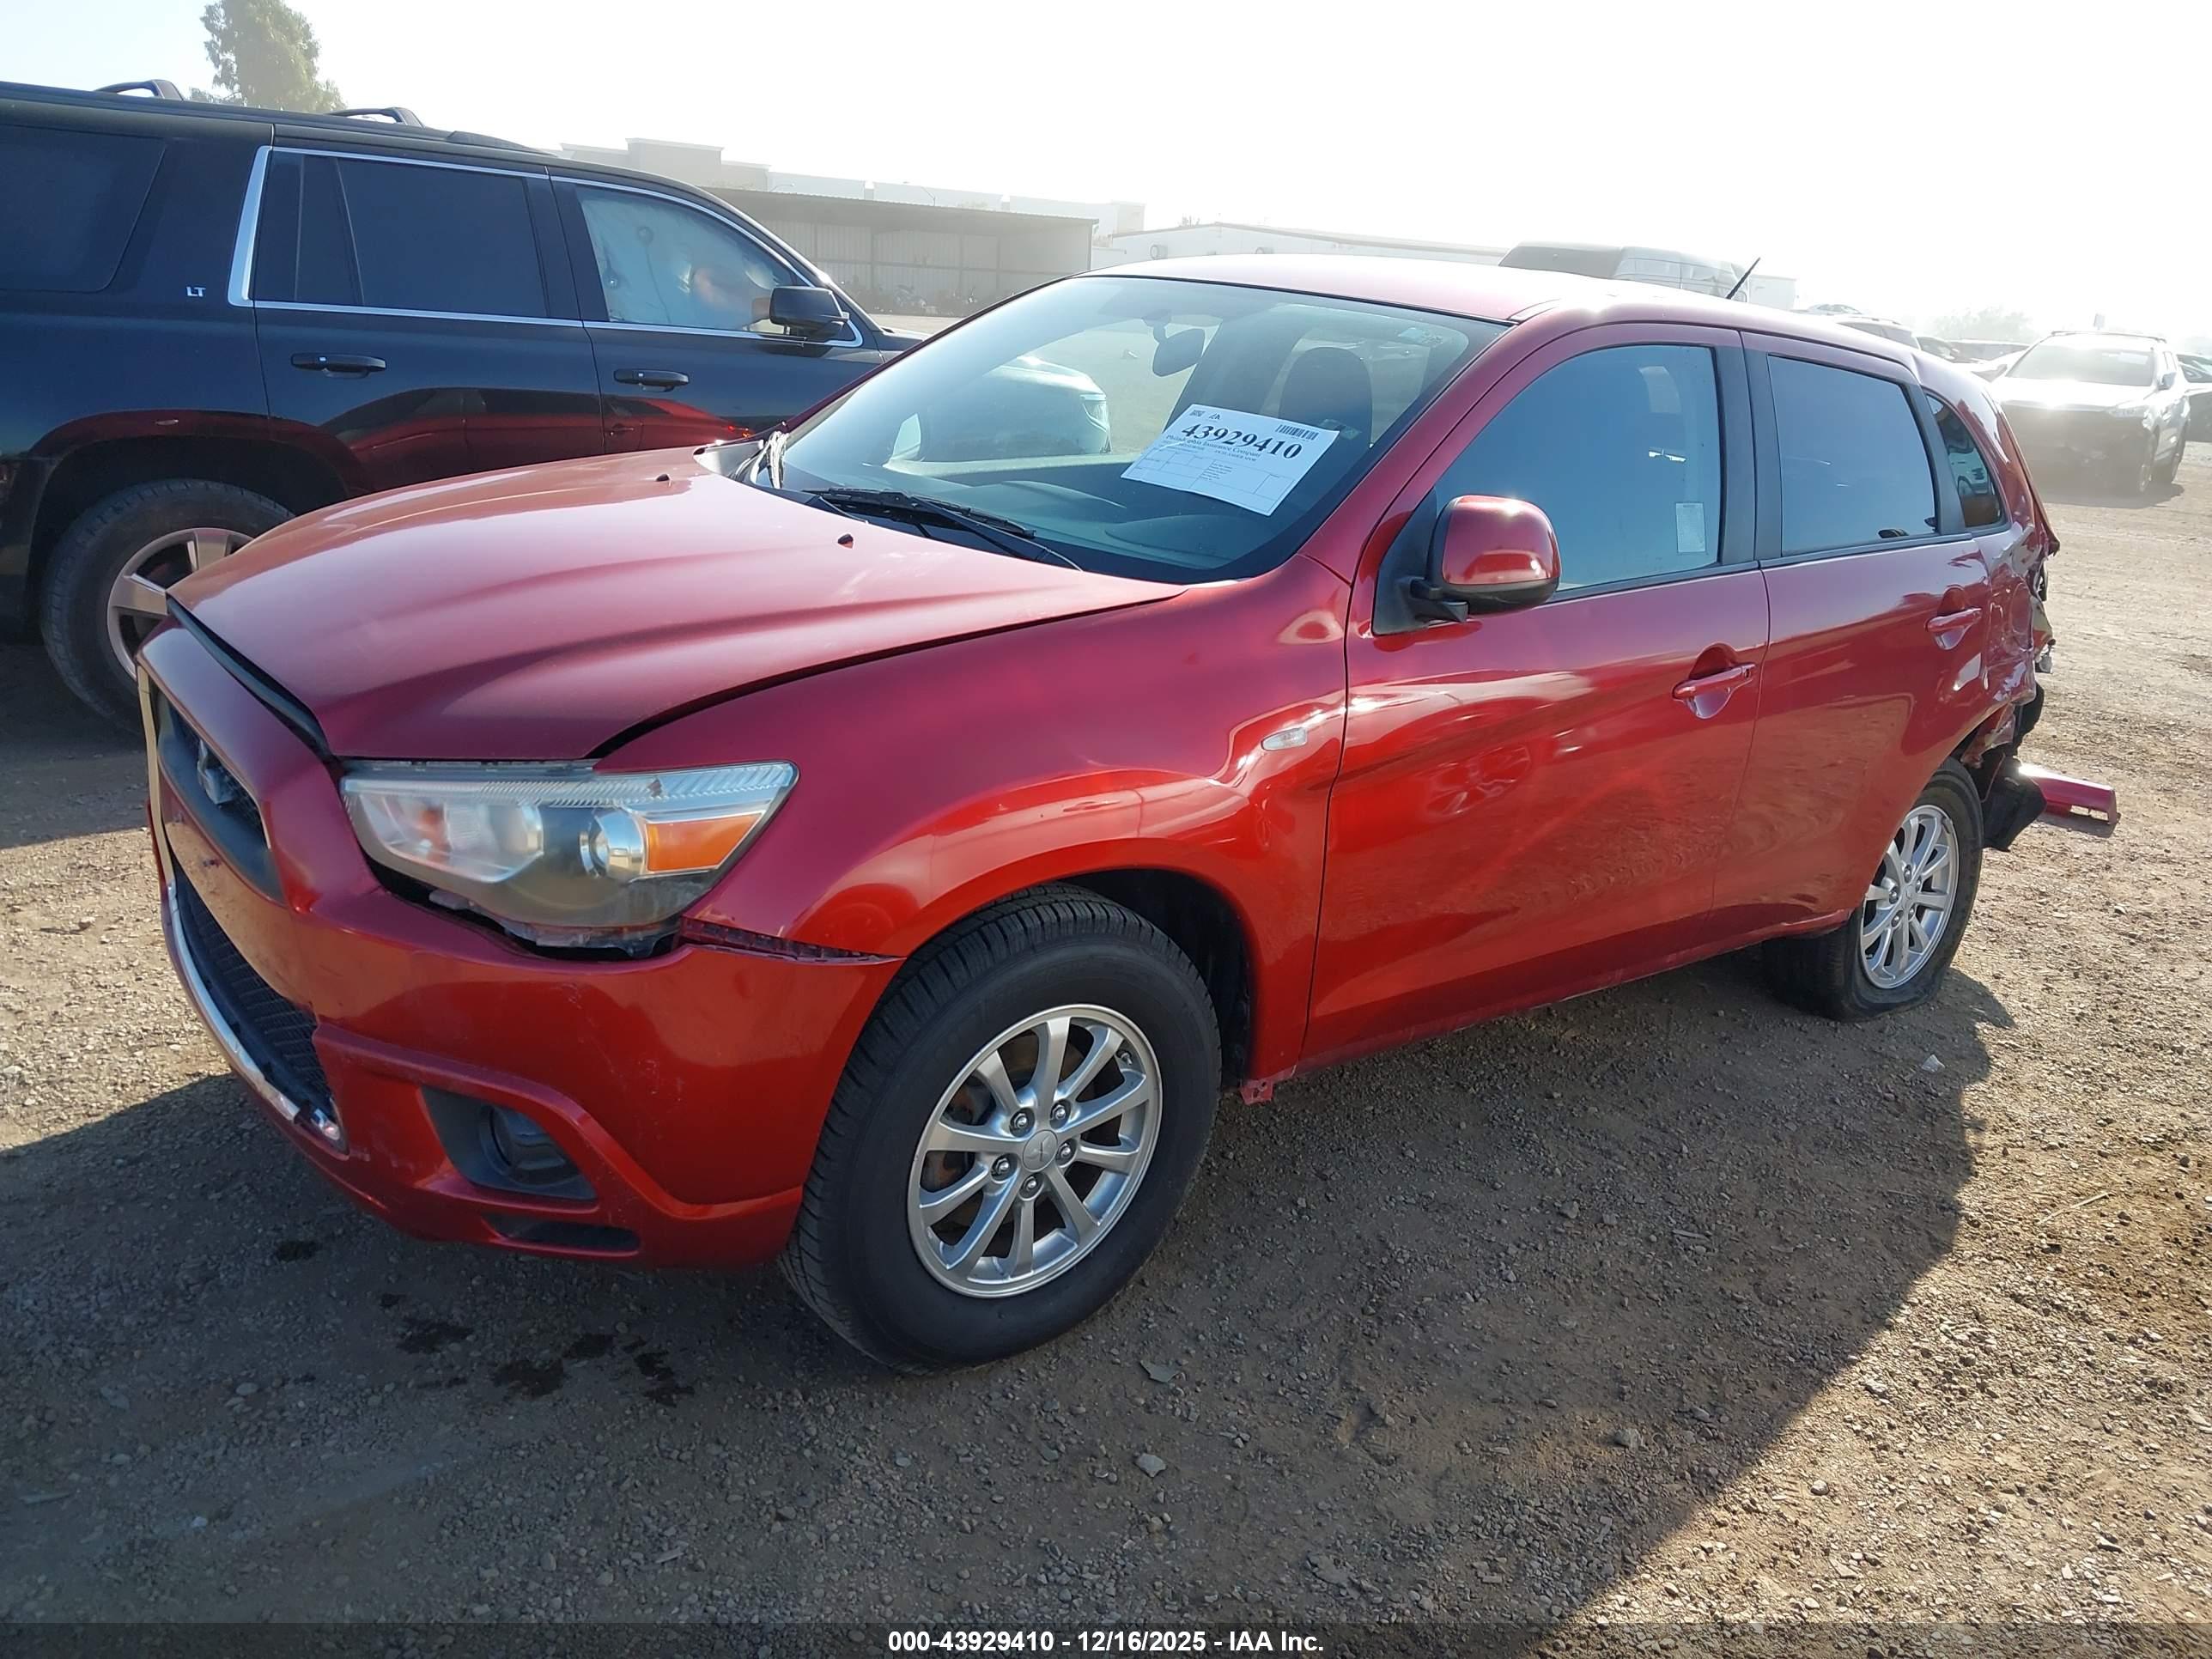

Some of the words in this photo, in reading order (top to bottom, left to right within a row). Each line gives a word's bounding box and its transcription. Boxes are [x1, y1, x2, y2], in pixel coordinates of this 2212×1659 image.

[185, 286, 206, 297] LT
[1166, 434, 1202, 446] Philadlphia
[1182, 423, 1303, 459] 43929410
